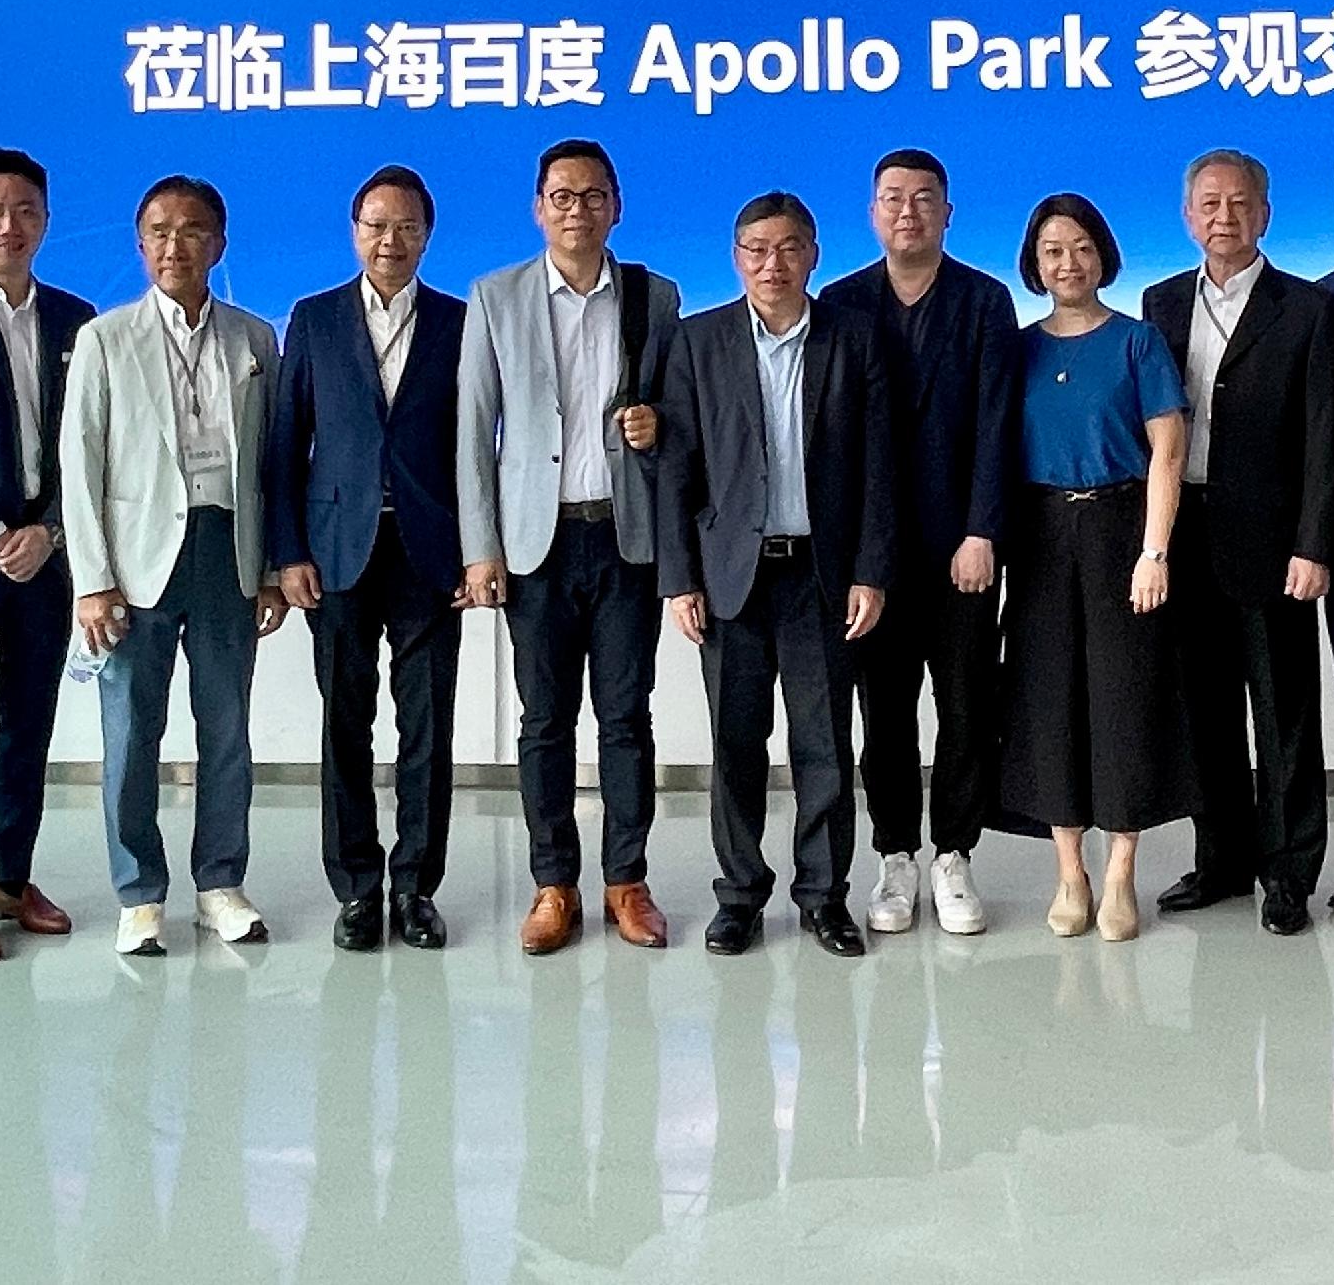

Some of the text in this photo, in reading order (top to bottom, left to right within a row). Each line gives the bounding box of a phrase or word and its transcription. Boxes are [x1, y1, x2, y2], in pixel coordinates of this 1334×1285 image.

[124, 19, 606, 114] 莅临上海百度
[629, 17, 900, 115] Apollo
[931, 14, 1112, 91] Park
